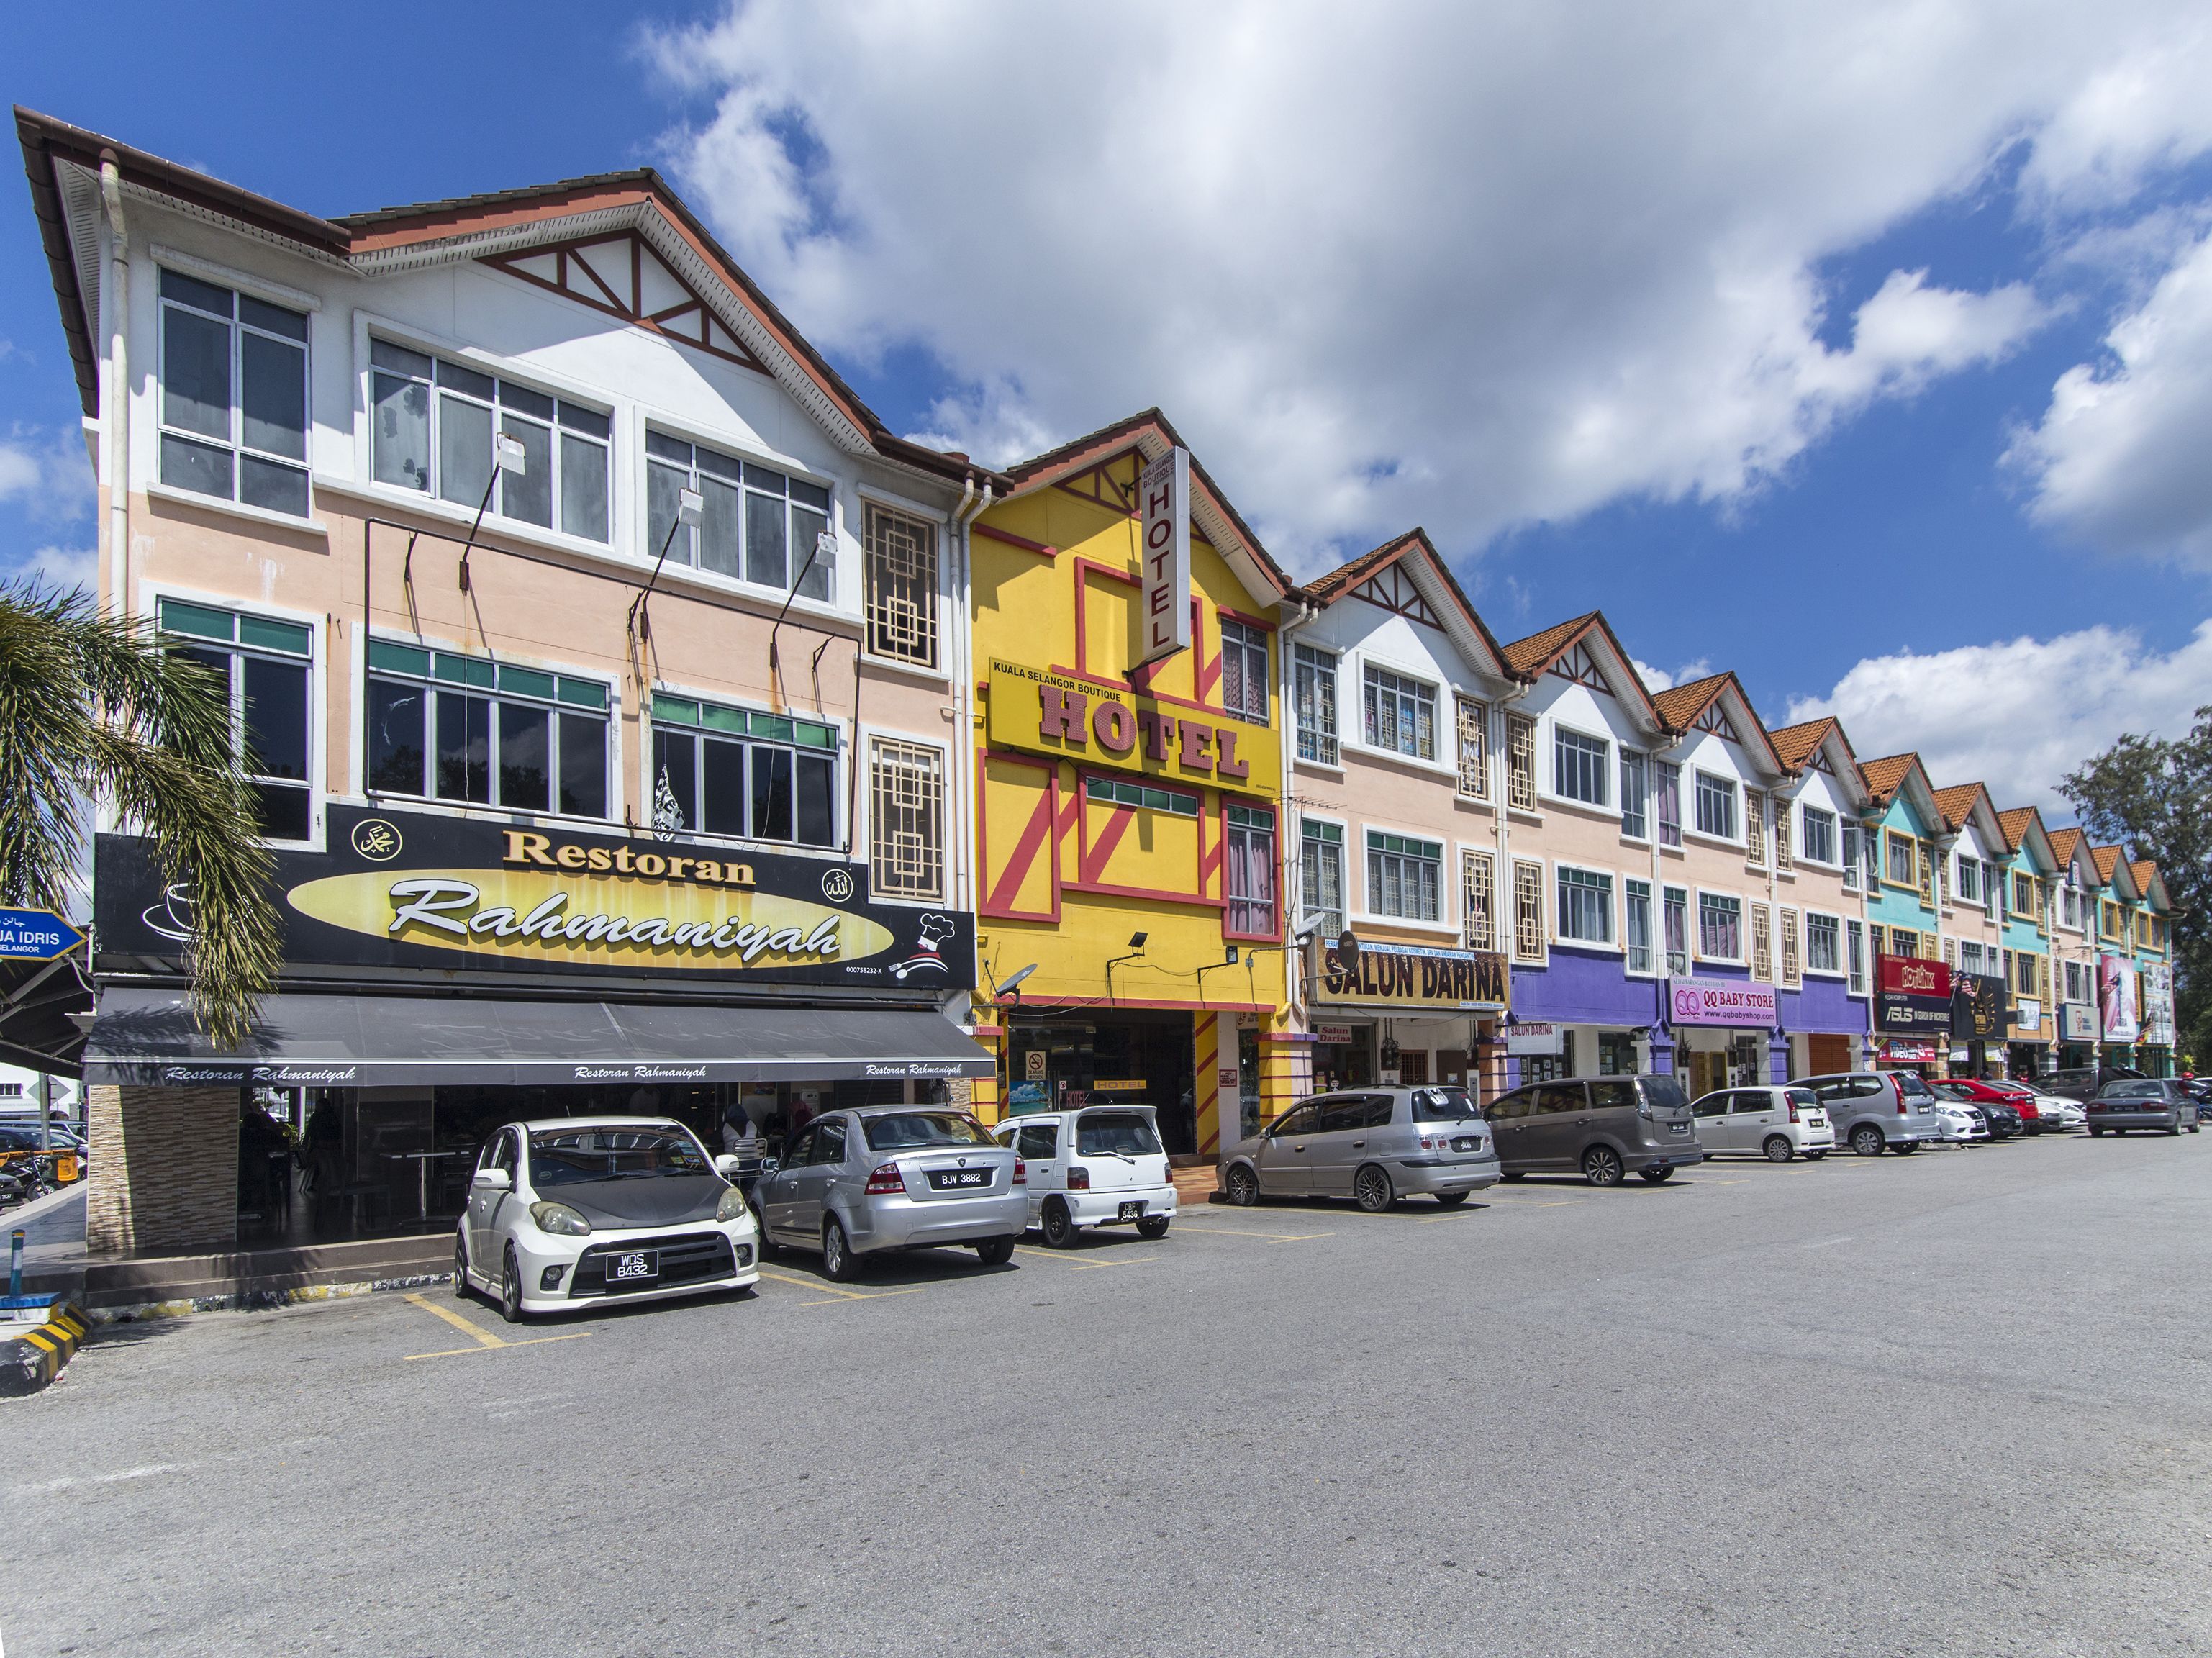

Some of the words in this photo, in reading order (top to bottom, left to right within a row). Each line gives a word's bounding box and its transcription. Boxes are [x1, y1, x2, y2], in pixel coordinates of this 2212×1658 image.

[1155, 453, 1174, 471] SELANGOR
[1143, 462, 1174, 488] BOUTIQUE
[1148, 483, 1171, 648] HOTEL
[994, 661, 1025, 678] KUALA
[1028, 670, 1075, 690] SELANGOR
[1078, 684, 1120, 702] BOUTIQUE
[1038, 684, 1250, 779] HOTEL
[504, 829, 756, 886] Restoran
[389, 879, 841, 962] Rahmaniyah
[19, 931, 60, 945] IDRIS
[1325, 948, 1413, 997] SALUN
[1422, 956, 1505, 1002] DARINA
[1703, 990, 1718, 1007] QQ
[1719, 992, 1744, 1006] BABY
[1746, 994, 1774, 1008] STORE
[1704, 1010, 1774, 1020] www.qqbabyshop.com
[1886, 1007, 1913, 1022] ASUS
[1511, 1025, 1530, 1037] SALUN
[1531, 1025, 1553, 1036] DARINA
[165, 1066, 244, 1080] Restoran
[252, 1066, 356, 1083] Rahmaniyah
[575, 1066, 630, 1079] Restoran
[634, 1066, 707, 1079] Rahmaniyah
[866, 1064, 906, 1075] Restoran
[909, 1064, 961, 1075] Rahmaniyah
[1066, 1090, 1087, 1107] HOTEL
[942, 1174, 958, 1184] BJV
[961, 1173, 981, 1183] 3882
[621, 1254, 645, 1266] WQS
[617, 1264, 648, 1277] 8432
